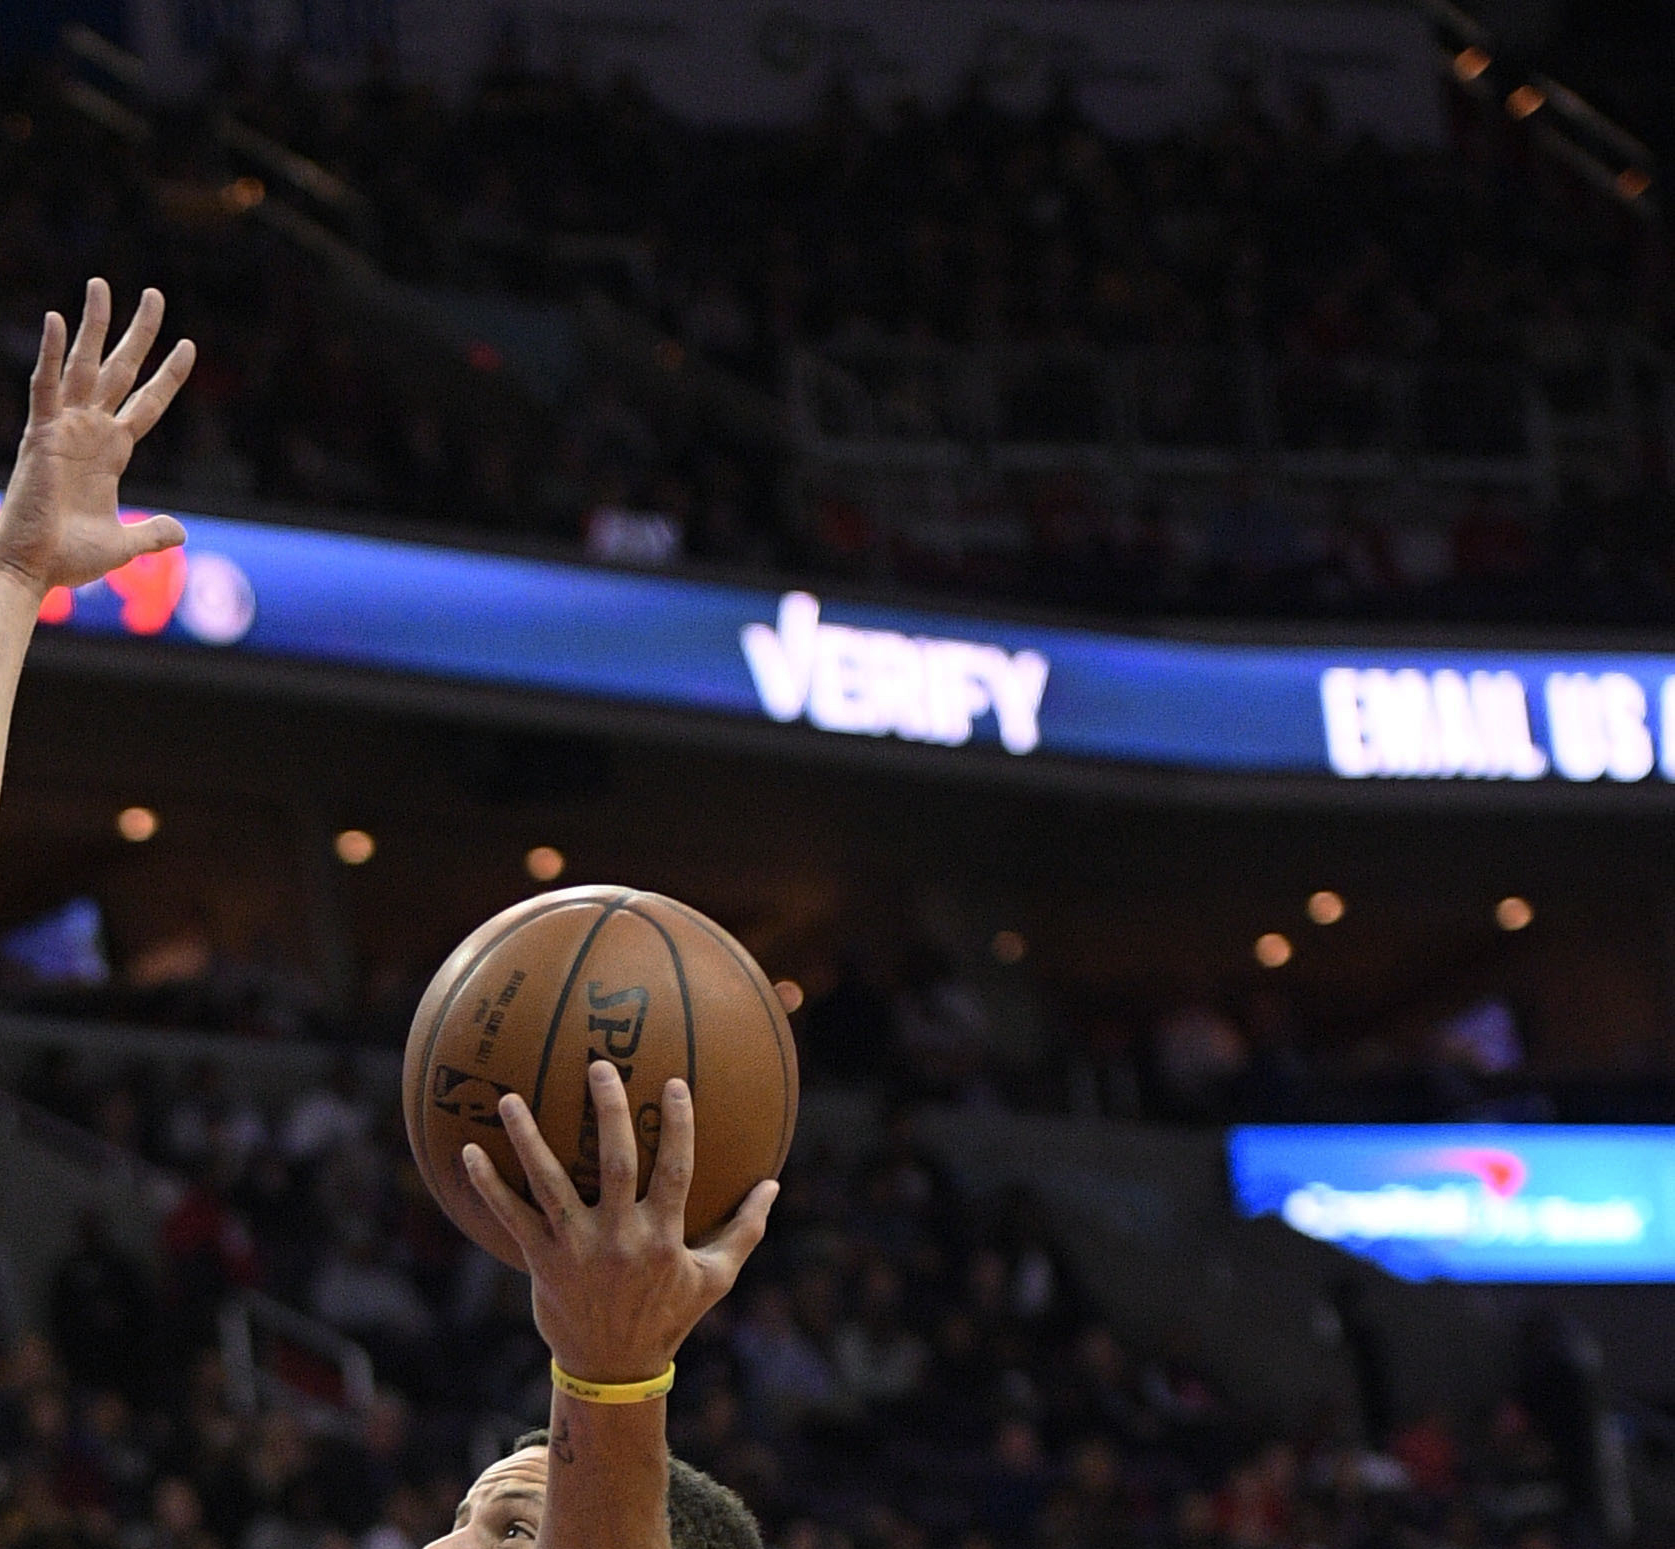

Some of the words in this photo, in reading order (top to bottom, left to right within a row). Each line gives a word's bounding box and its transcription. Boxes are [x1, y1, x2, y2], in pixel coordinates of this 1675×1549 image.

[740, 591, 1049, 755] VERIFY
[1320, 667, 1549, 781] EMAIL
[1545, 671, 1656, 783] US
